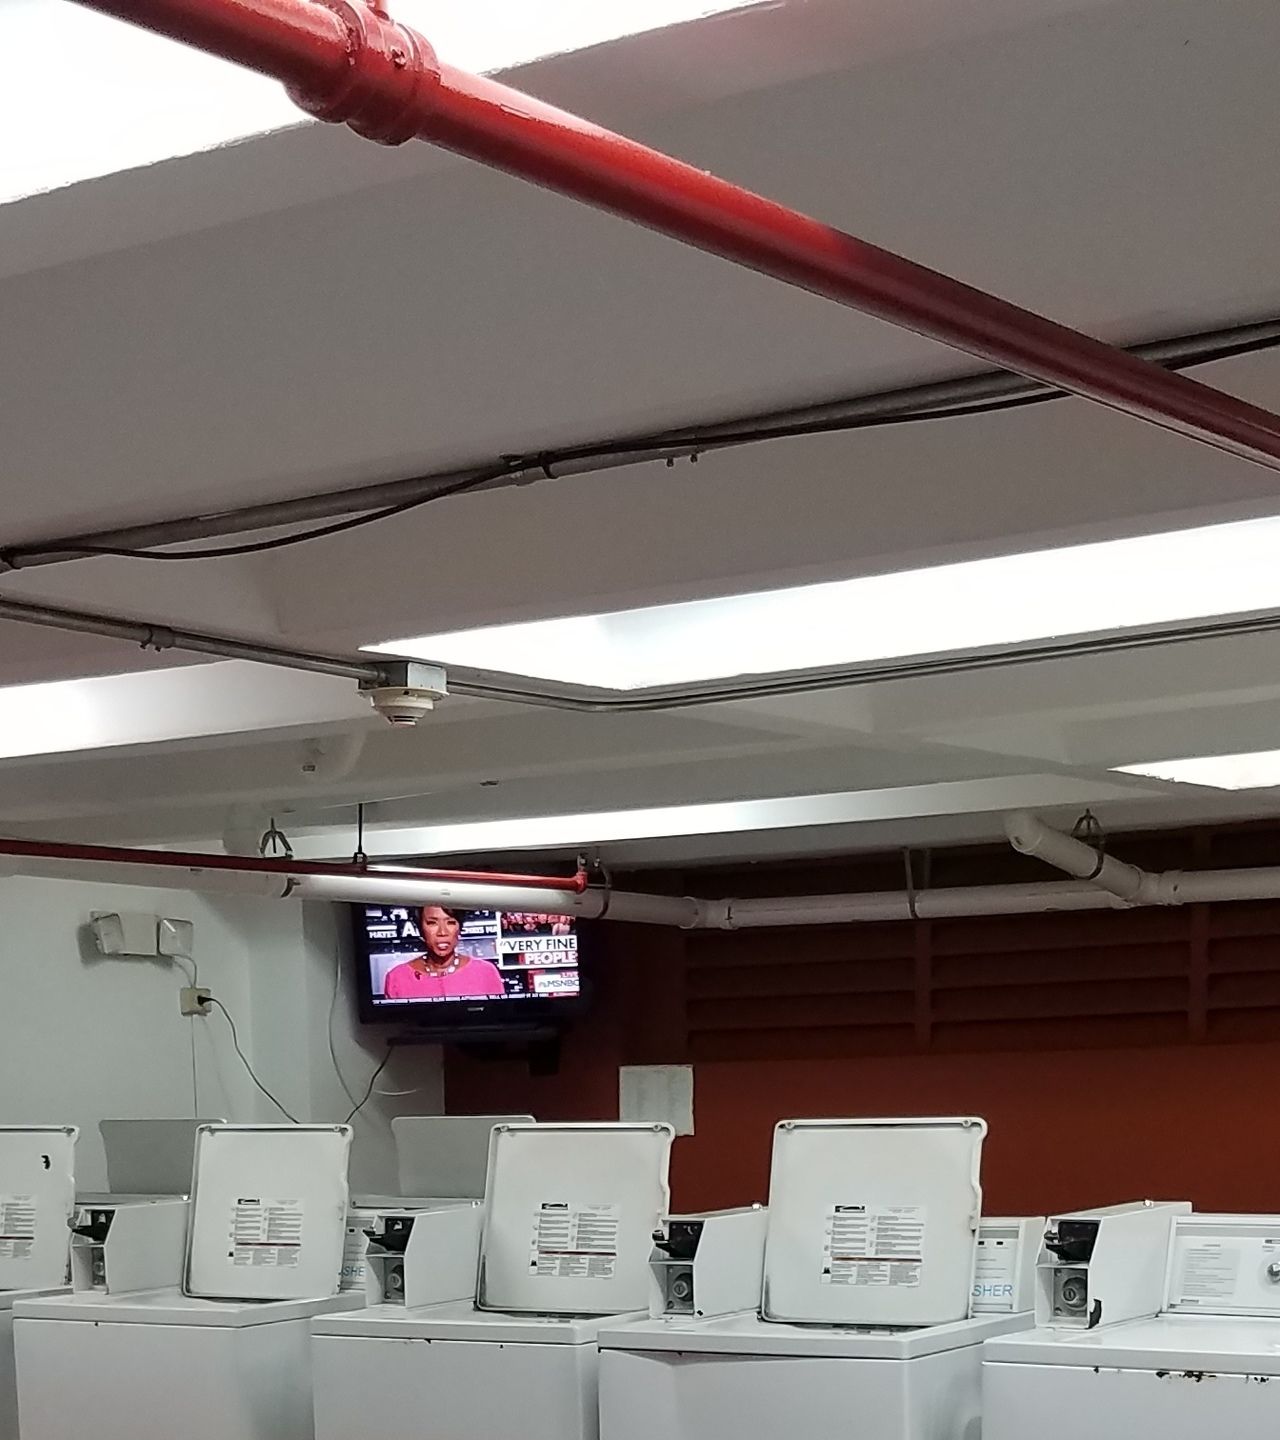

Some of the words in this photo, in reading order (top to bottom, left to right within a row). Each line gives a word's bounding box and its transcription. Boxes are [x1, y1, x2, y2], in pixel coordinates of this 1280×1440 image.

[546, 938, 575, 950] FINE
[342, 1266, 365, 1276] SHE
[972, 1285, 1013, 1297] SHER
